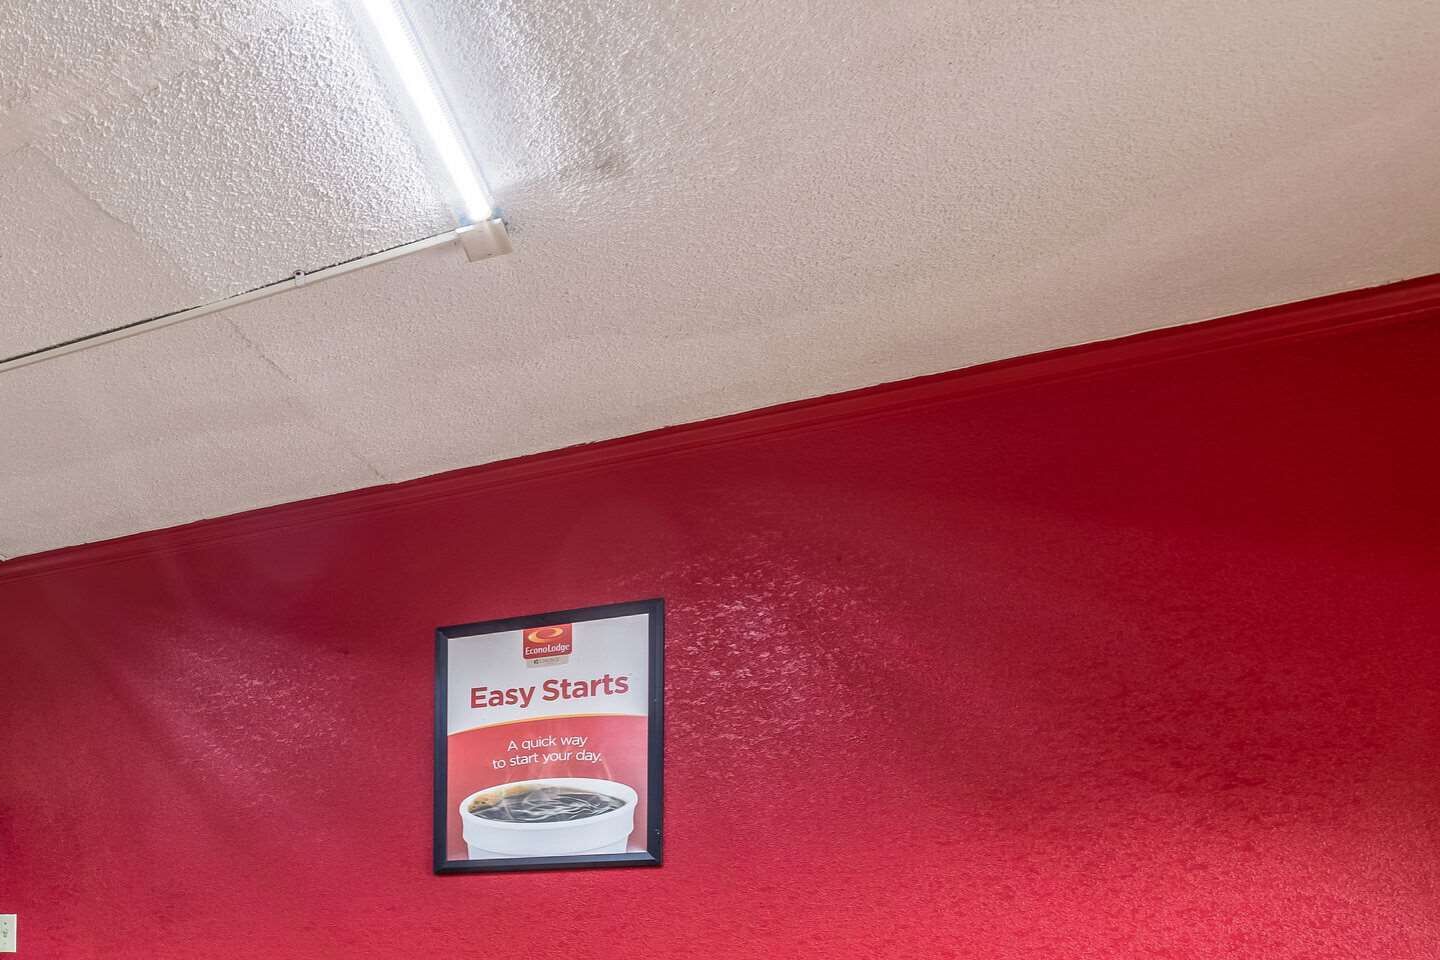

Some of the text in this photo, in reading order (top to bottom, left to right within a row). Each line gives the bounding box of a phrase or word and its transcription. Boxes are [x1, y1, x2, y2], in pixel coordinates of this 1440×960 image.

[470, 674, 629, 709] Easy Starts
[507, 735, 588, 752] A quick way
[492, 749, 602, 770] to start your day.
